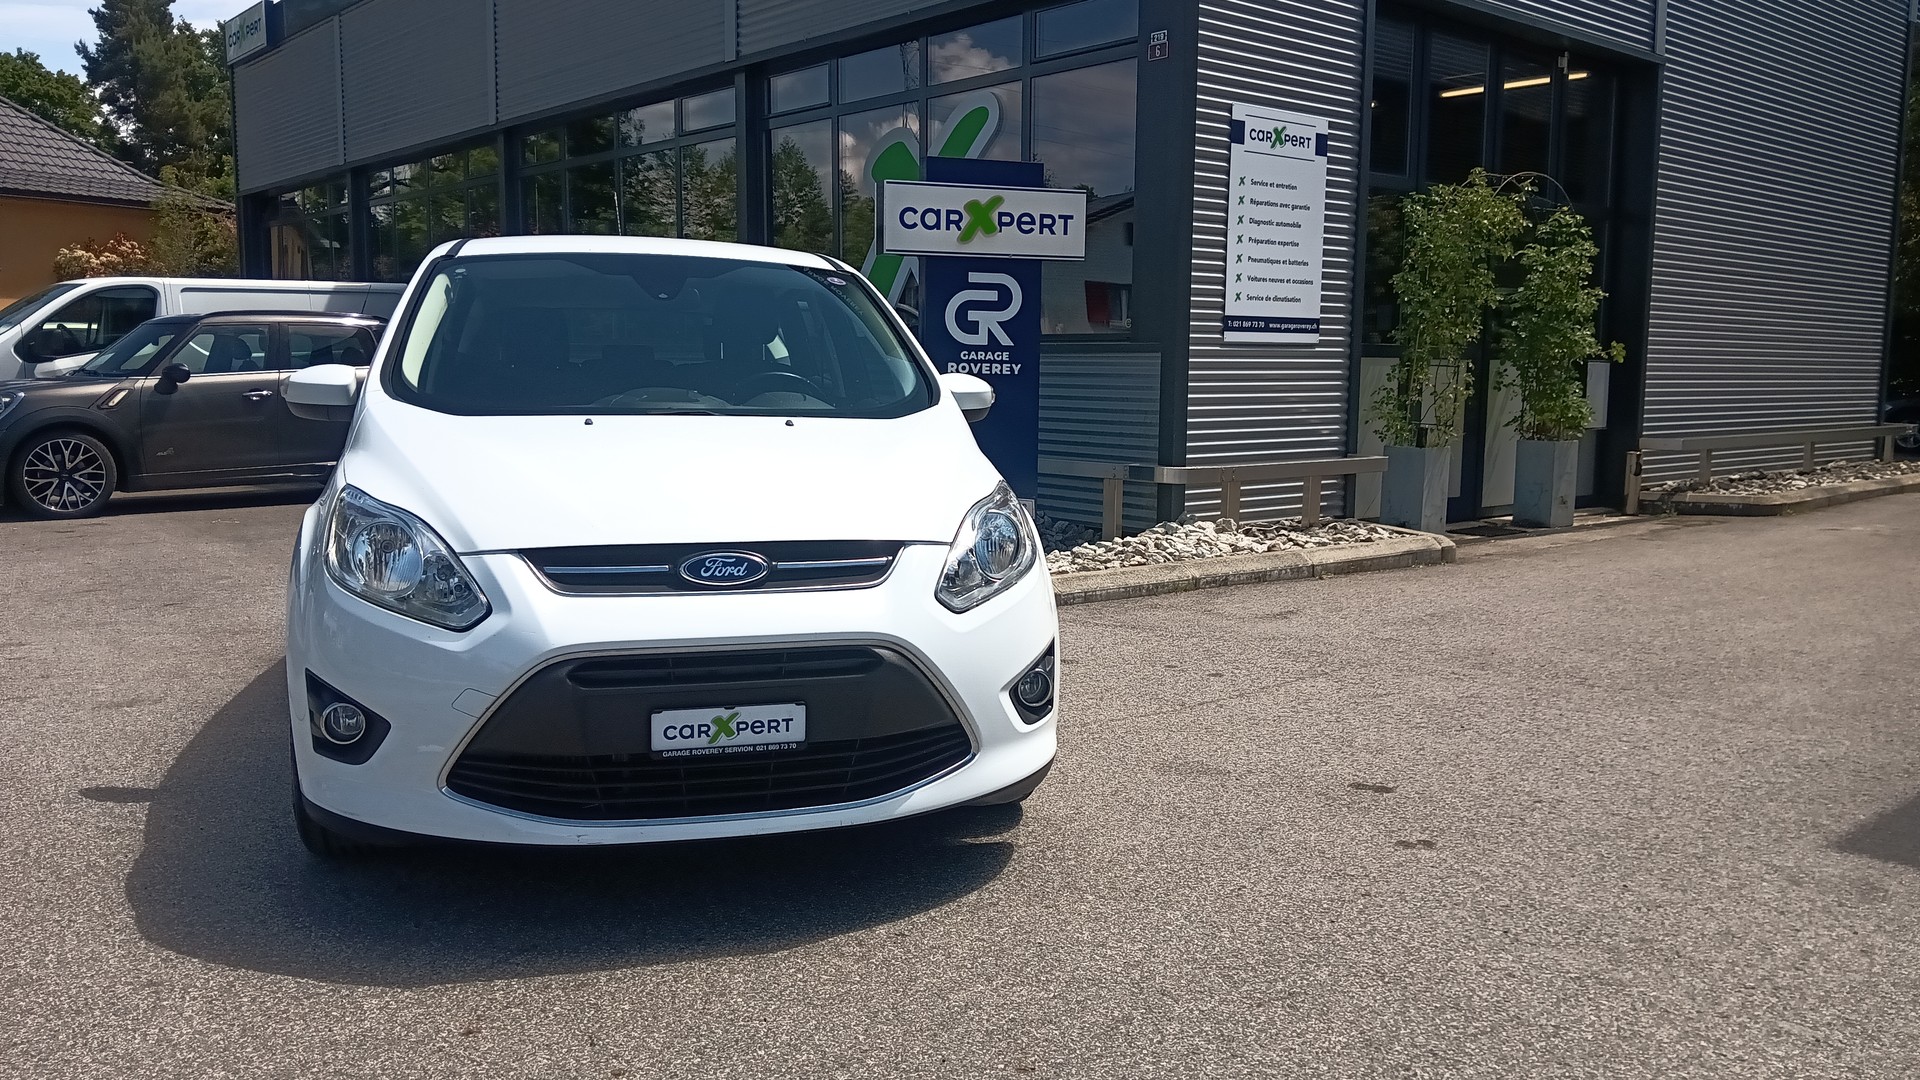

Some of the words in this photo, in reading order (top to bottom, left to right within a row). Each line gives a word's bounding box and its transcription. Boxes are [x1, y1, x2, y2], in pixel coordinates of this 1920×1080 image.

[1155, 45, 1161, 57] 6
[1250, 178, 1268, 187] Service
[1276, 183, 1297, 191] entretien
[1249, 197, 1279, 207] Réparations
[1248, 217, 1274, 227] Diagnostic
[1275, 220, 1302, 229] automobile
[1248, 236, 1277, 246] Préparation
[1277, 240, 1300, 248] expertise
[1247, 255, 1281, 265] Pneumatiques
[1288, 258, 1309, 267] batteries
[1246, 274, 1267, 283] Voitures
[1246, 293, 1264, 301] Service
[1272, 294, 1302, 303] climatisation
[1233, 320, 1242, 328] 021
[960, 350, 1010, 361] GARAGE
[947, 362, 1022, 375] ROVEREY
[701, 557, 748, 577] Ford
[692, 747, 723, 755] ROVEREY
